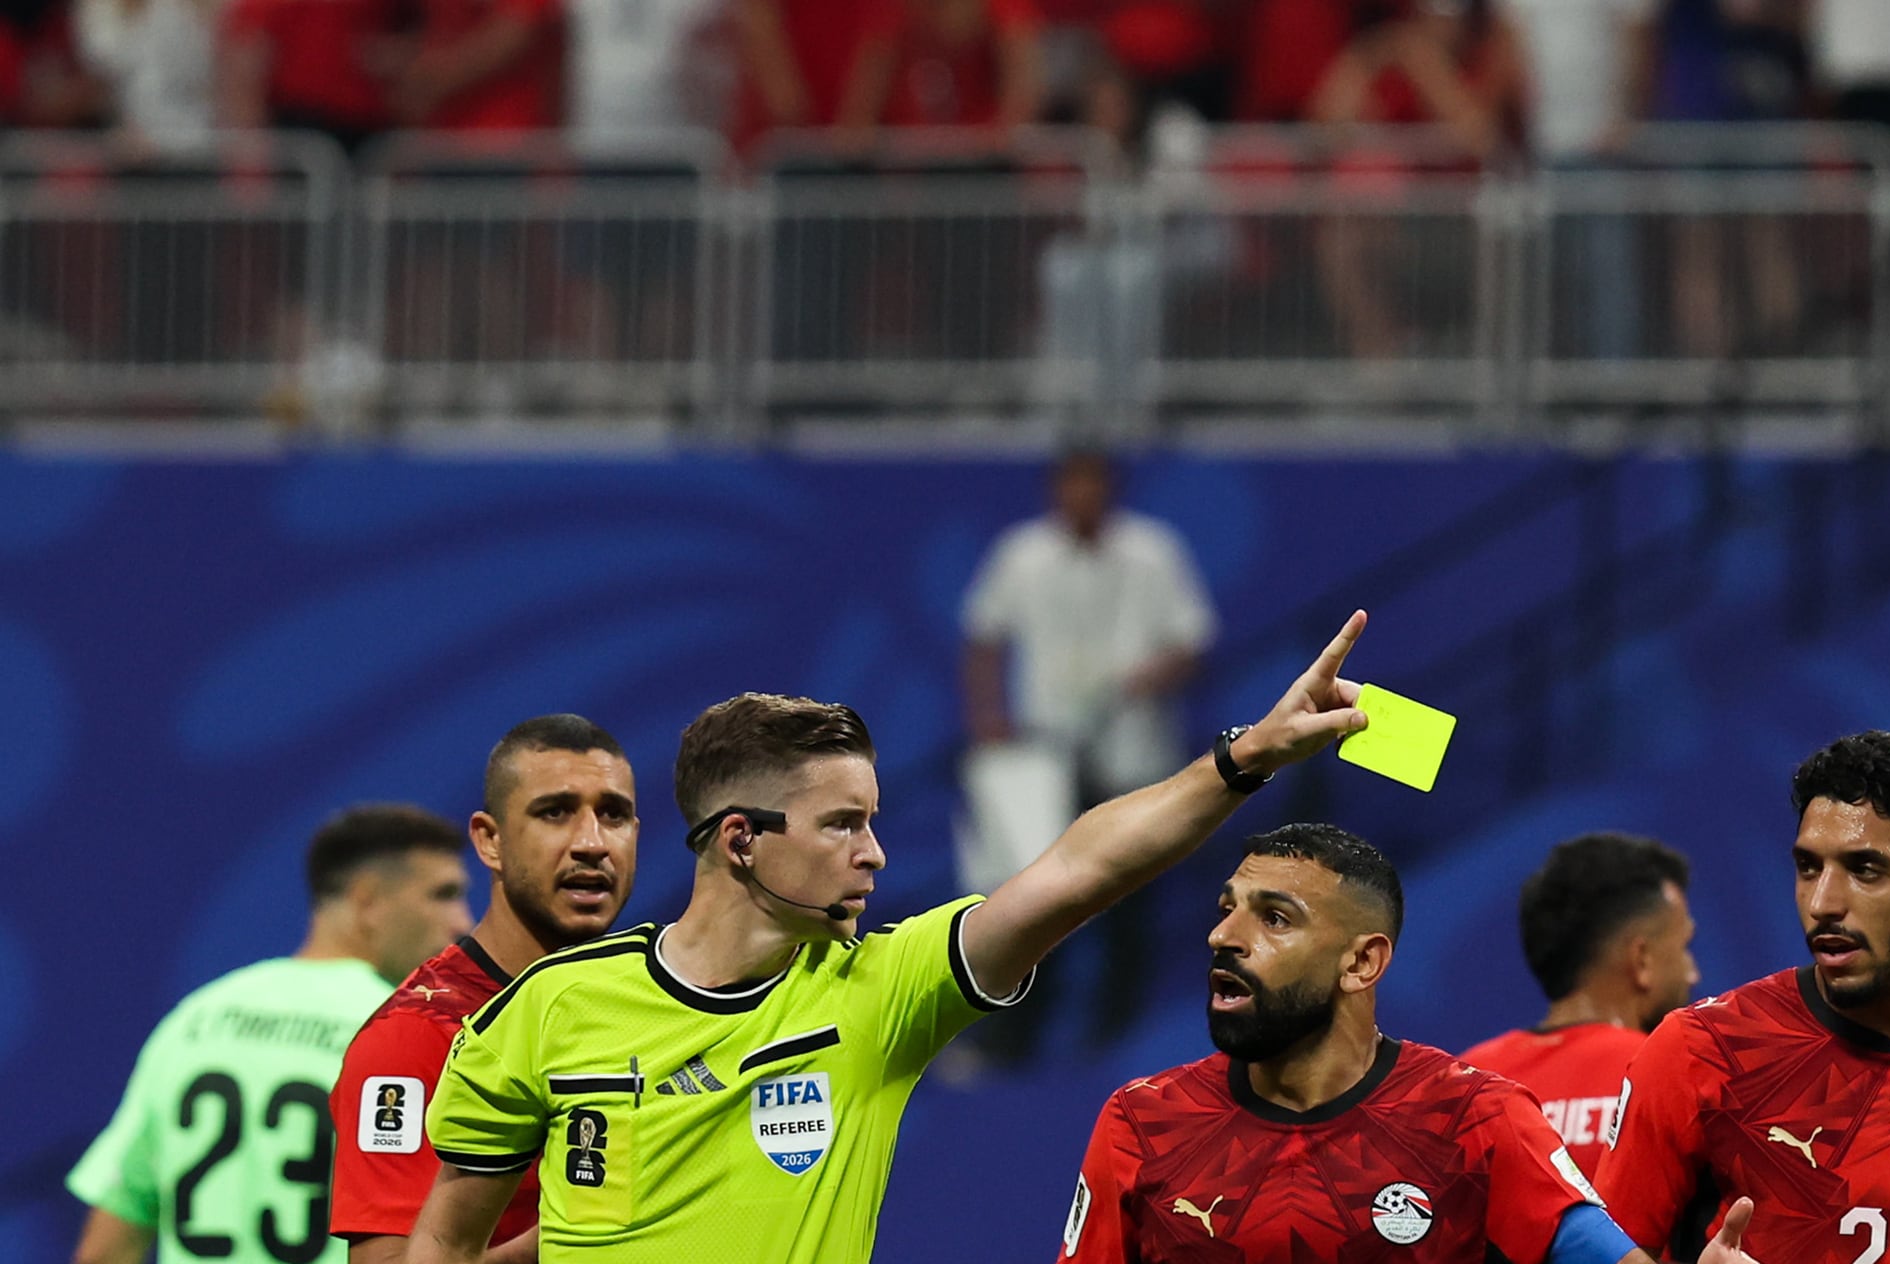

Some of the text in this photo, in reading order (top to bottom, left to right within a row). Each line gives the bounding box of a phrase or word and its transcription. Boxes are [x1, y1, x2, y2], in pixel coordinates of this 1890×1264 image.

[758, 1080, 823, 1107] FIFA
[759, 1119, 826, 1136] REFEREE
[373, 1138, 402, 1146] 2026
[781, 1153, 811, 1166] 2026
[576, 1170, 595, 1181] FIFA
